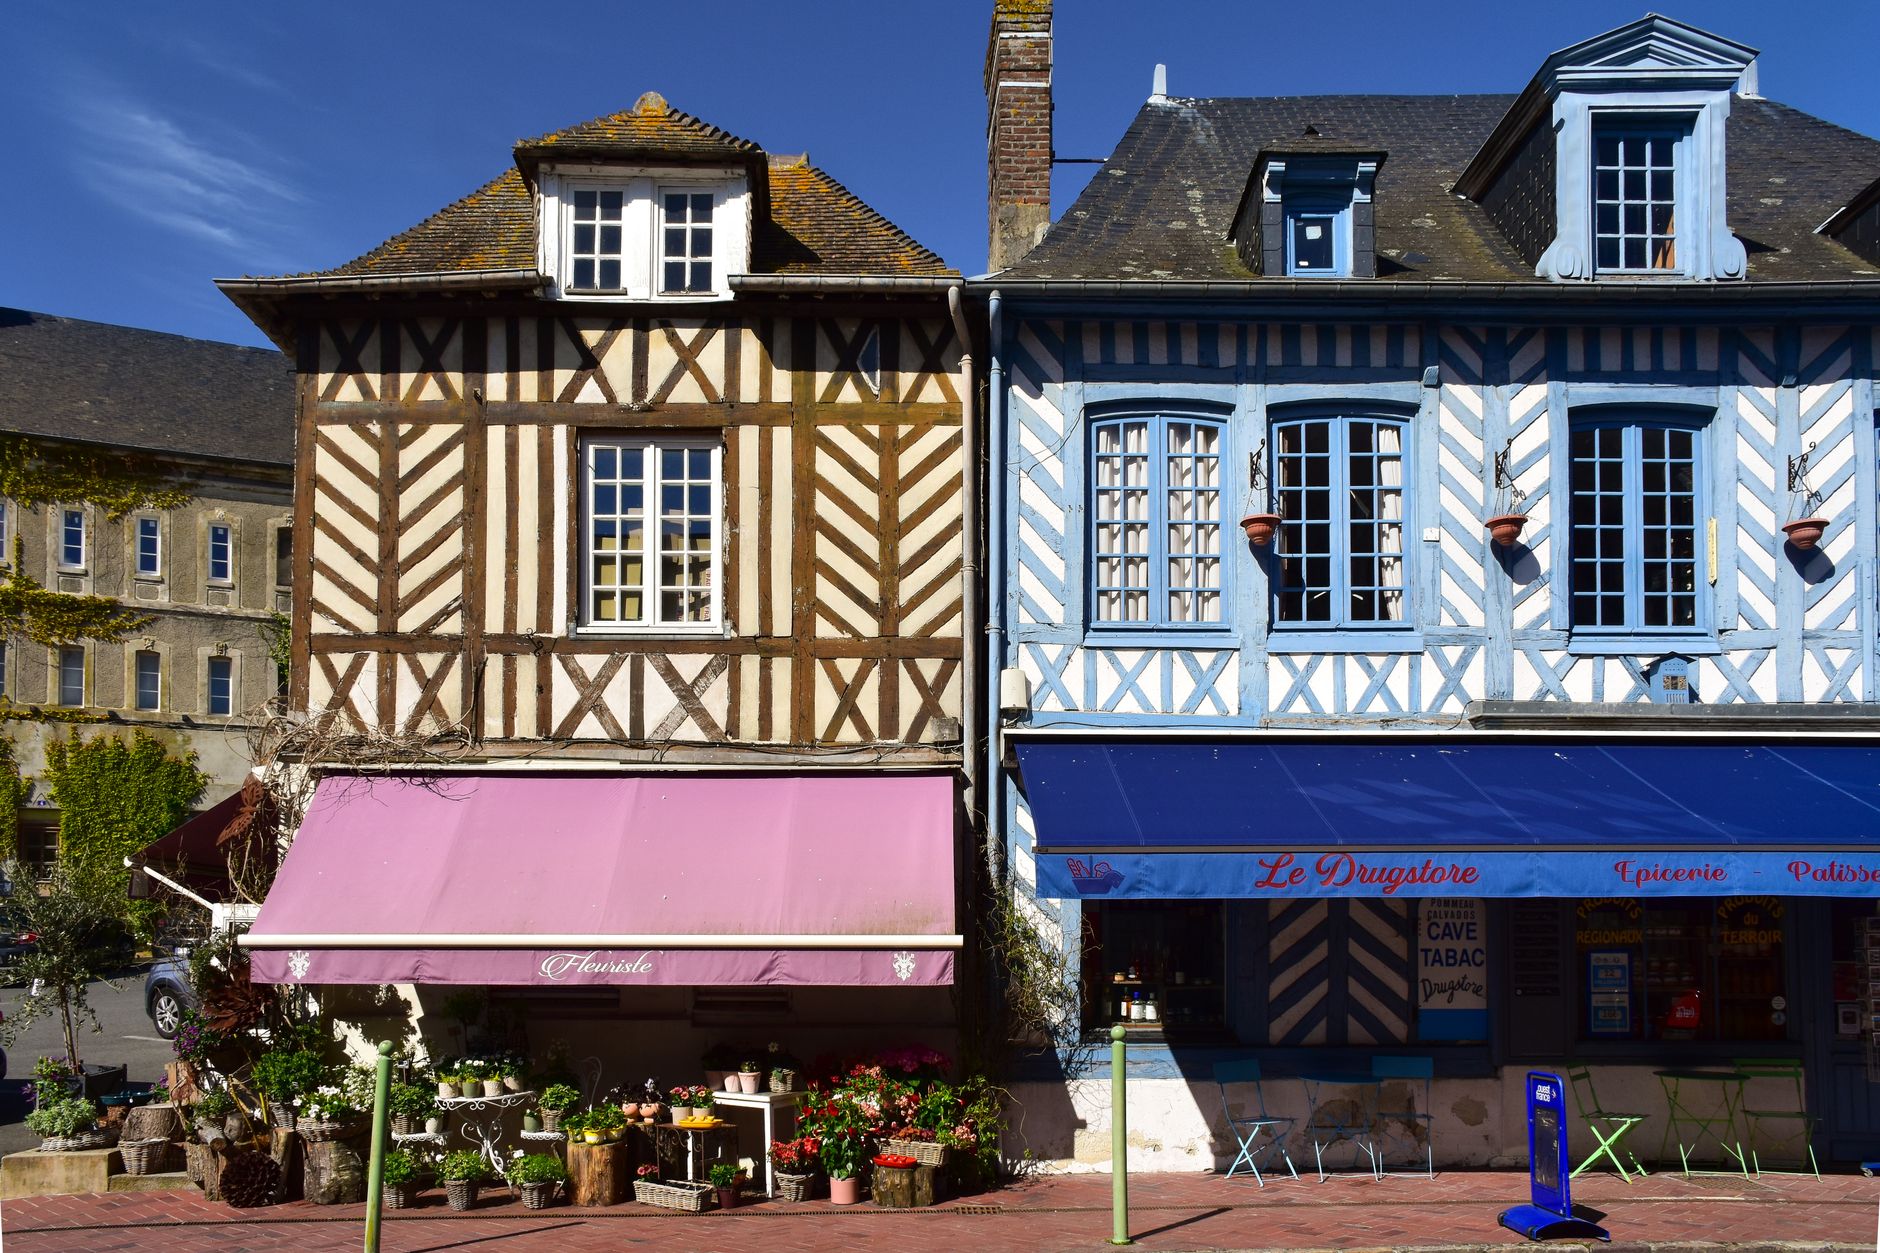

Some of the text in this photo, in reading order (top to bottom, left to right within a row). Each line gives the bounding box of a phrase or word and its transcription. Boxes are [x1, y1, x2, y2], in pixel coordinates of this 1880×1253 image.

[1254, 852, 1480, 895] Le Drugstore
[1614, 860, 1728, 888] Epicerie
[1430, 898, 1474, 908] POMMEAU
[1716, 896, 1784, 919] PRODUITS
[1427, 910, 1476, 921] CALVADOS
[1743, 911, 1759, 926] du
[1427, 922, 1477, 940] CAVE
[1720, 930, 1783, 945] TERROIR
[538, 950, 654, 981] Fleuriste
[1420, 948, 1485, 967] TABAC
[1421, 975, 1485, 1003] Drugstore
